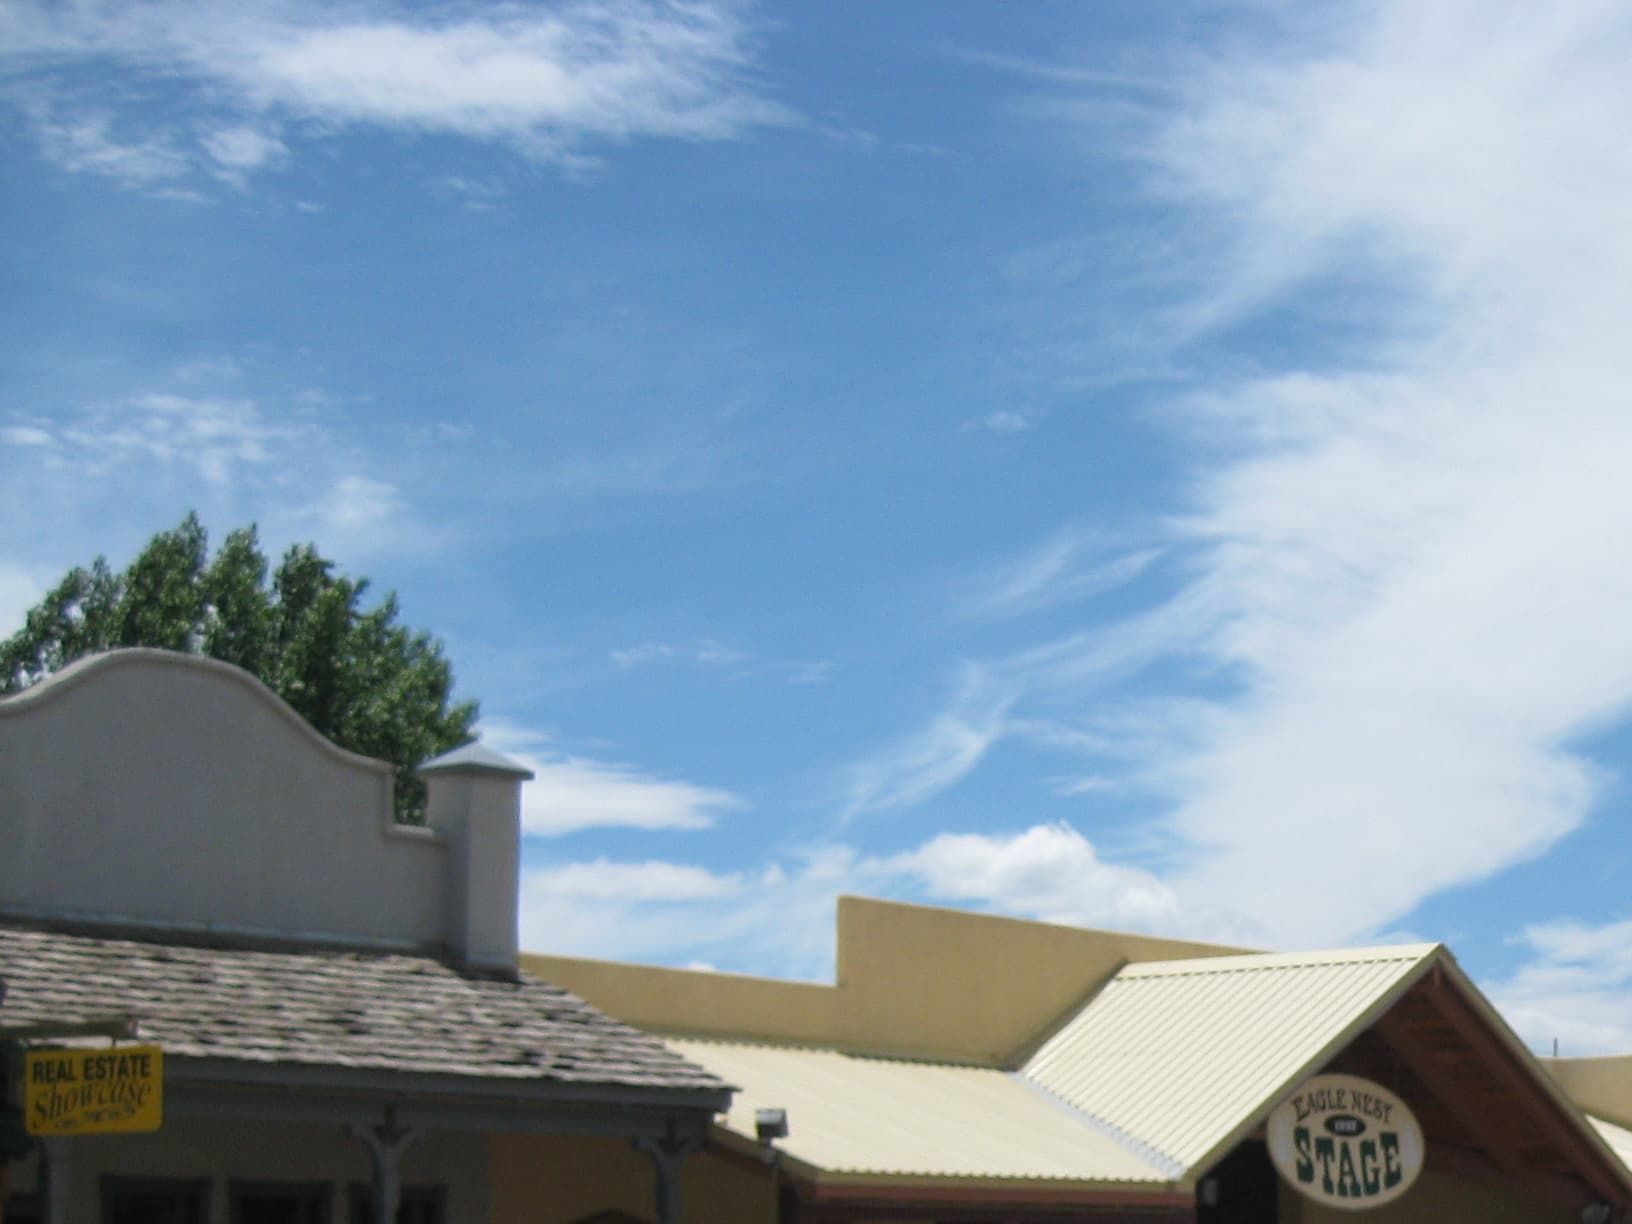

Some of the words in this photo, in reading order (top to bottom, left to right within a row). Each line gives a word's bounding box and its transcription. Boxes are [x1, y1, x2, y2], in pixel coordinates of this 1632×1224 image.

[33, 1058, 76, 1084] REAL
[84, 1053, 152, 1080] ESTATE
[35, 1080, 152, 1119] Showcase
[1292, 1087, 1347, 1121] EAGLE
[1352, 1089, 1393, 1124] NEST
[1293, 1124, 1402, 1198] STAGE
